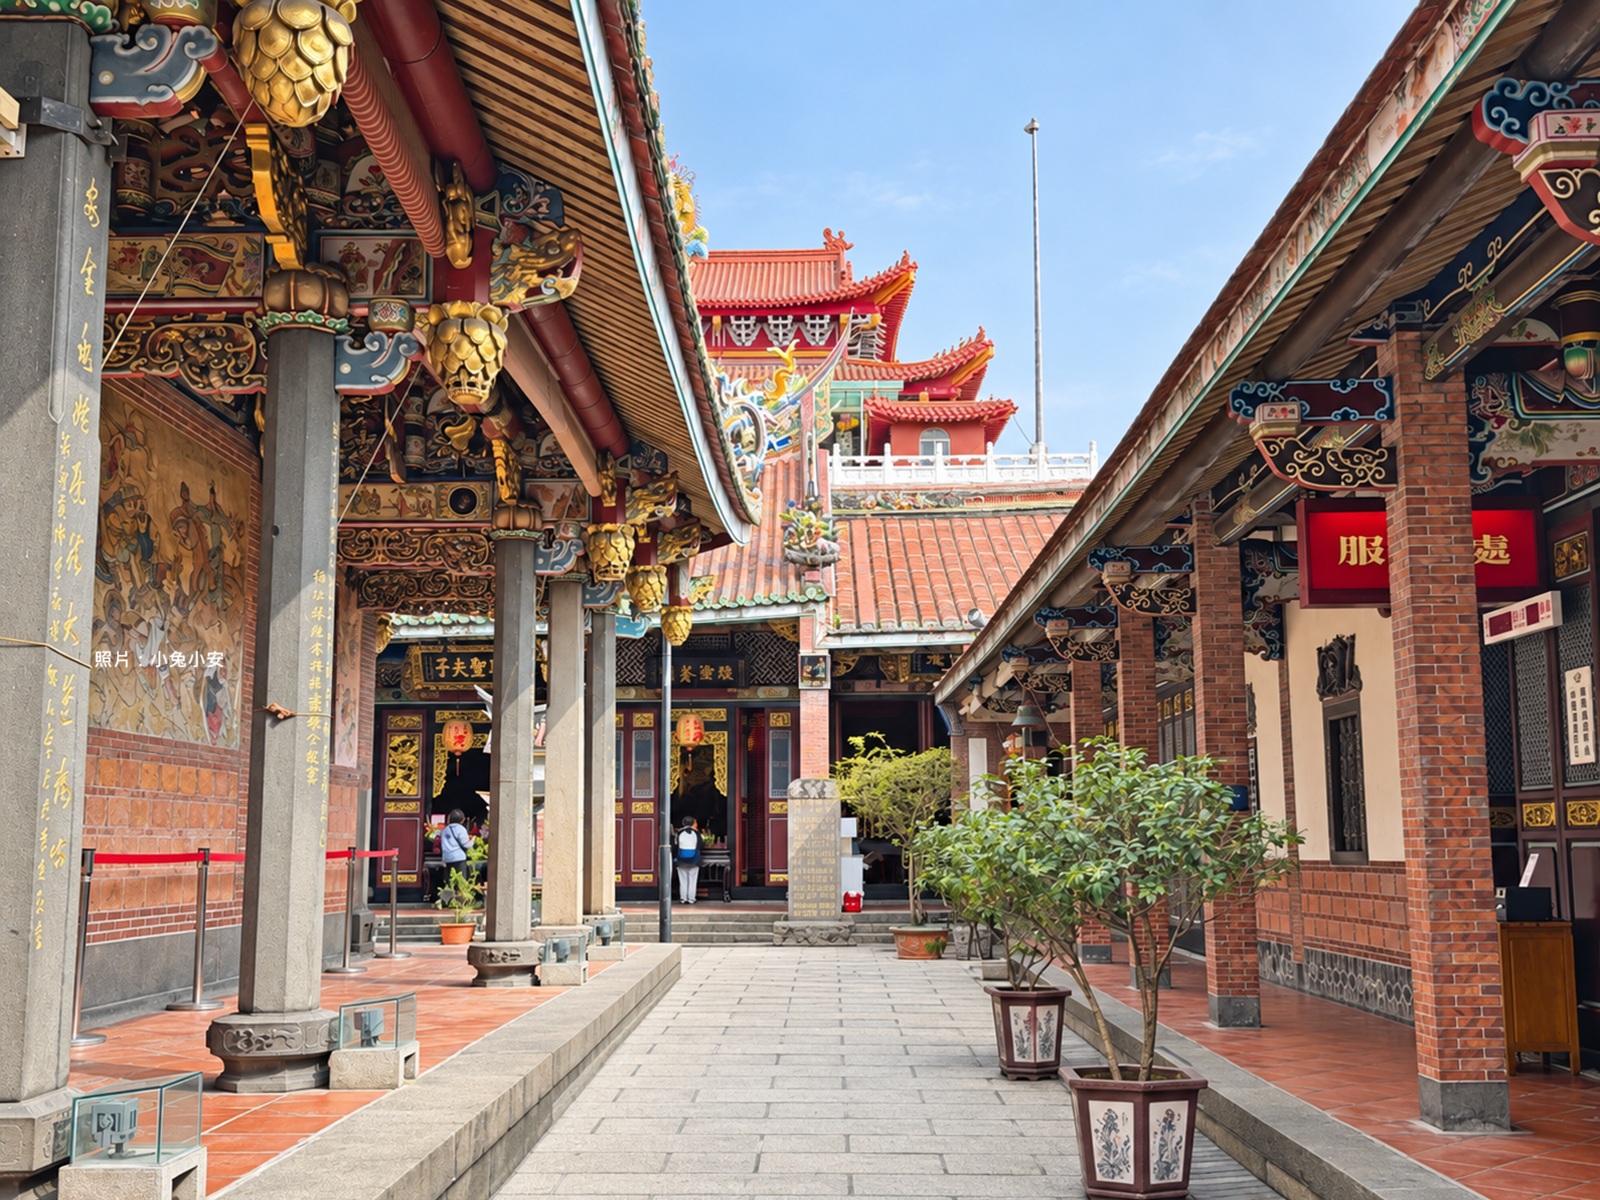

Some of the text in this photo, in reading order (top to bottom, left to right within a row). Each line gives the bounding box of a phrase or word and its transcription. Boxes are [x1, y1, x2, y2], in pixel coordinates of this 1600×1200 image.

[1338, 534, 1511, 566] 服處
[435, 656, 494, 679] 聖夫子
